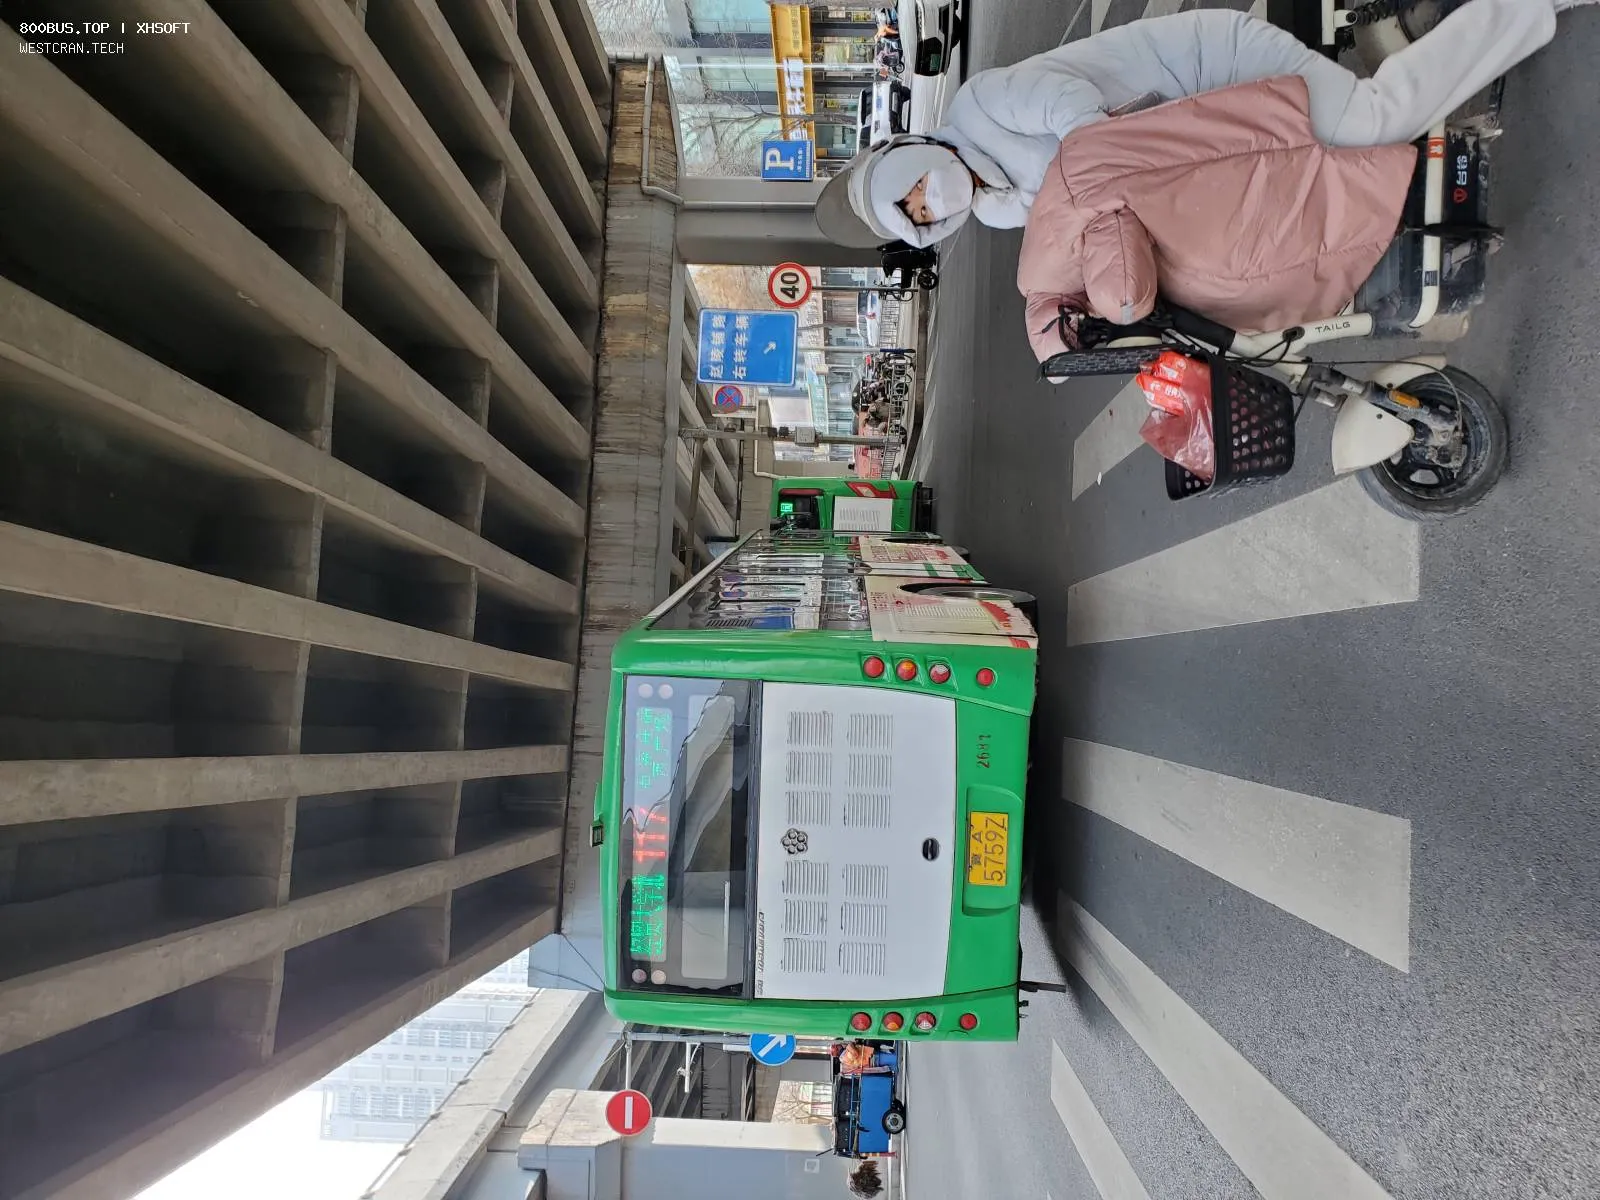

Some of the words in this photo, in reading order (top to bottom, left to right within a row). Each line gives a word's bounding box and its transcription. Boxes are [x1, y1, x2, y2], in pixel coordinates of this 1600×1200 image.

[764, 147, 794, 170] P
[1456, 154, 1468, 186] 台铃
[780, 272, 800, 300] 40
[1314, 321, 1351, 334] TAILG
[732, 315, 750, 380] 右转车辆
[632, 808, 667, 864] 117
[984, 816, 1005, 882] 5759Z
